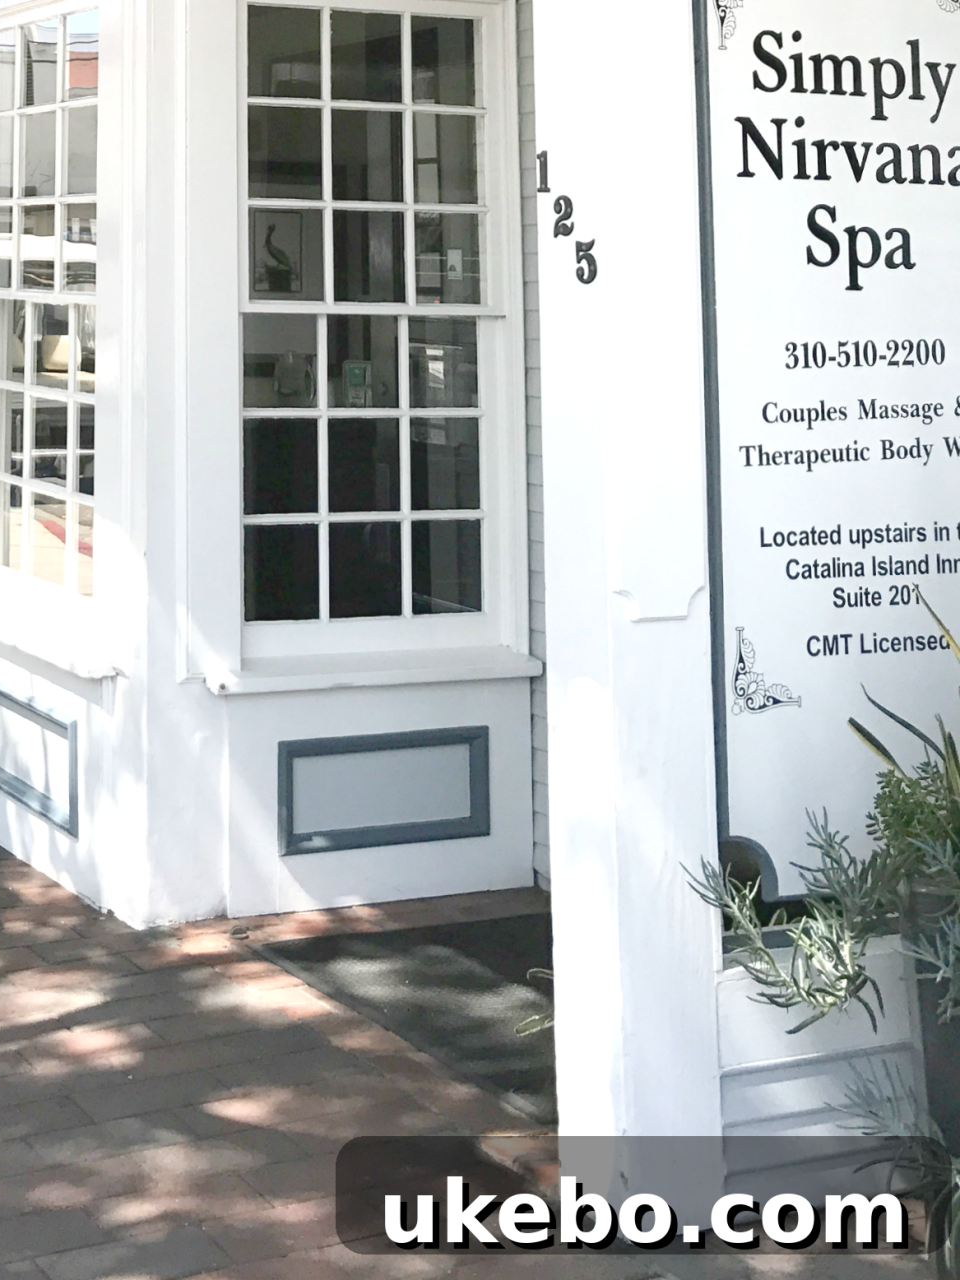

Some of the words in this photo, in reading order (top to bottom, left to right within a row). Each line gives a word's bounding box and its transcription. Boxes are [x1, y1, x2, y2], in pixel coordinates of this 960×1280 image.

[752, 29, 957, 124] Simply
[806, 204, 916, 291] Spa
[784, 338, 946, 369] 310-510-2200
[762, 400, 848, 430] Couples
[857, 398, 944, 425] Massage
[739, 440, 870, 472] Therapeutic
[880, 437, 934, 466] Body
[760, 524, 841, 548] Located
[849, 522, 927, 549] upstairs
[933, 521, 950, 542] in
[785, 556, 865, 580] Catalina
[872, 554, 929, 576] Island
[832, 586, 882, 609] Suite
[888, 584, 920, 606] 201
[806, 634, 853, 657] CMT
